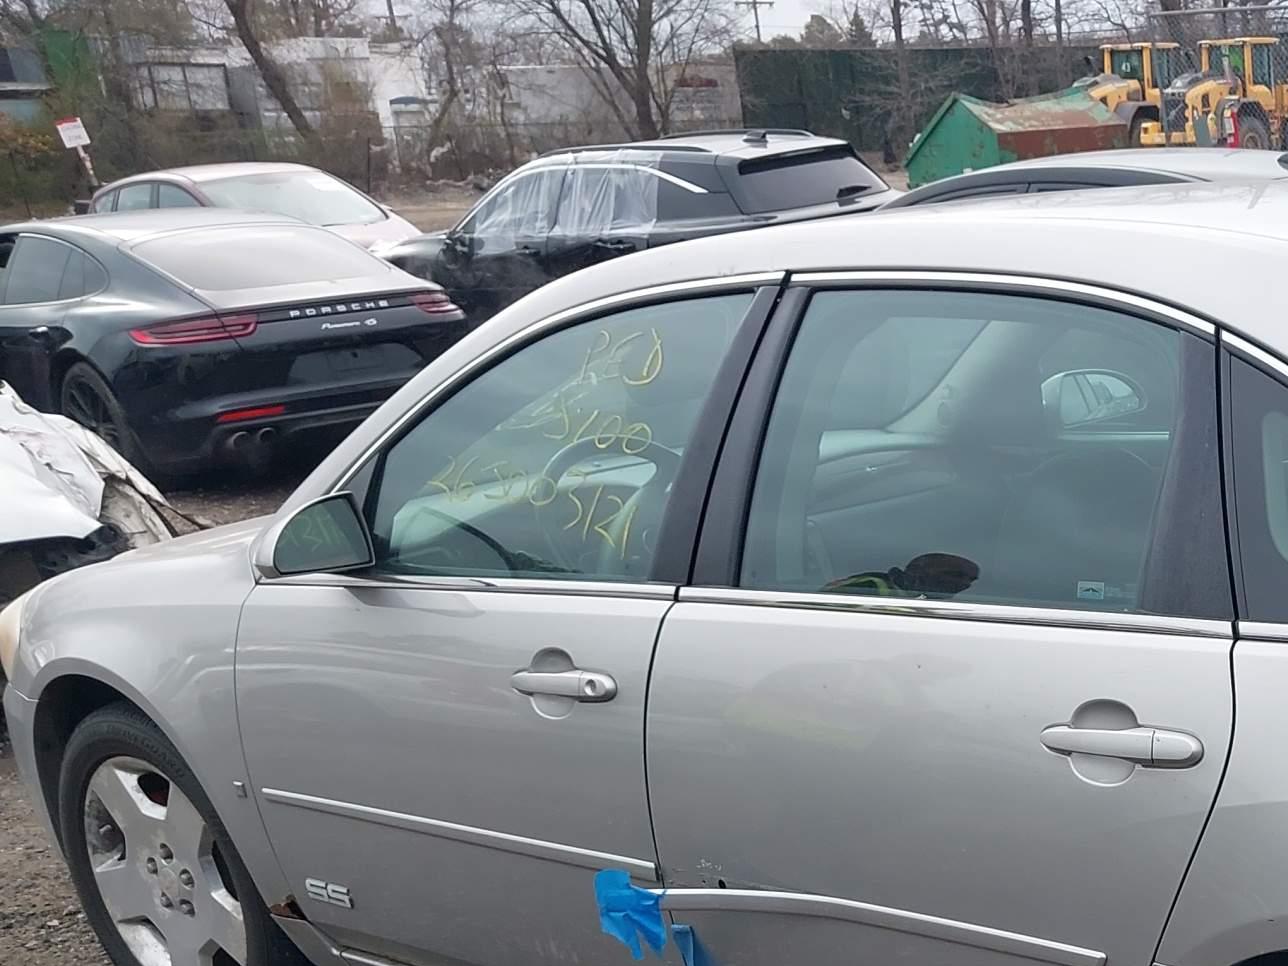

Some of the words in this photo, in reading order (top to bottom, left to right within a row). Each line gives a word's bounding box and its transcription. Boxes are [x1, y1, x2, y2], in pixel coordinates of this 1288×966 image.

[288, 299, 390, 318] PORSCHE
[578, 327, 665, 386] RED
[304, 877, 353, 909] SS
